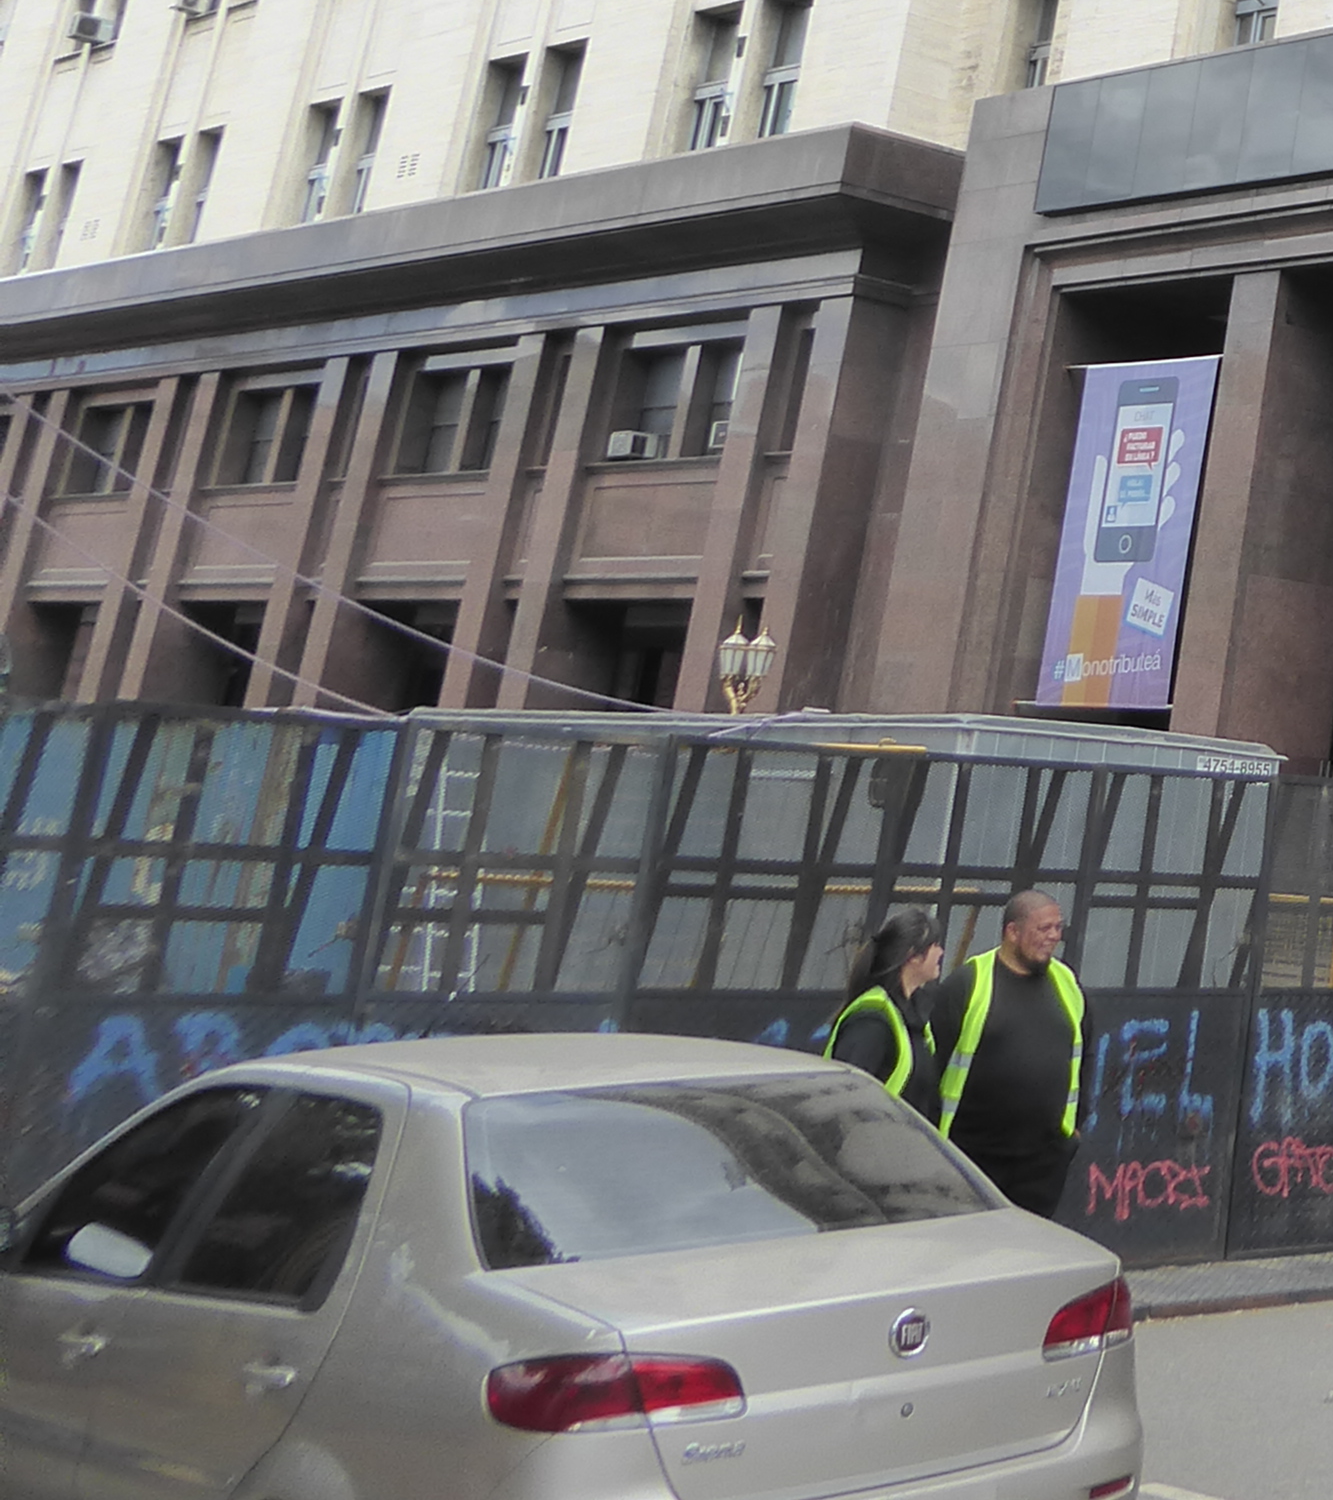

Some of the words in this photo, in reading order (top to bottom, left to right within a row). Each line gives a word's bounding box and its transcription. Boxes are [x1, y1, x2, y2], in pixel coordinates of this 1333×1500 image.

[1131, 604, 1165, 628] SIMPLE
[1054, 648, 1161, 680] #Monotributeá
[901, 1321, 924, 1347] FIAT
